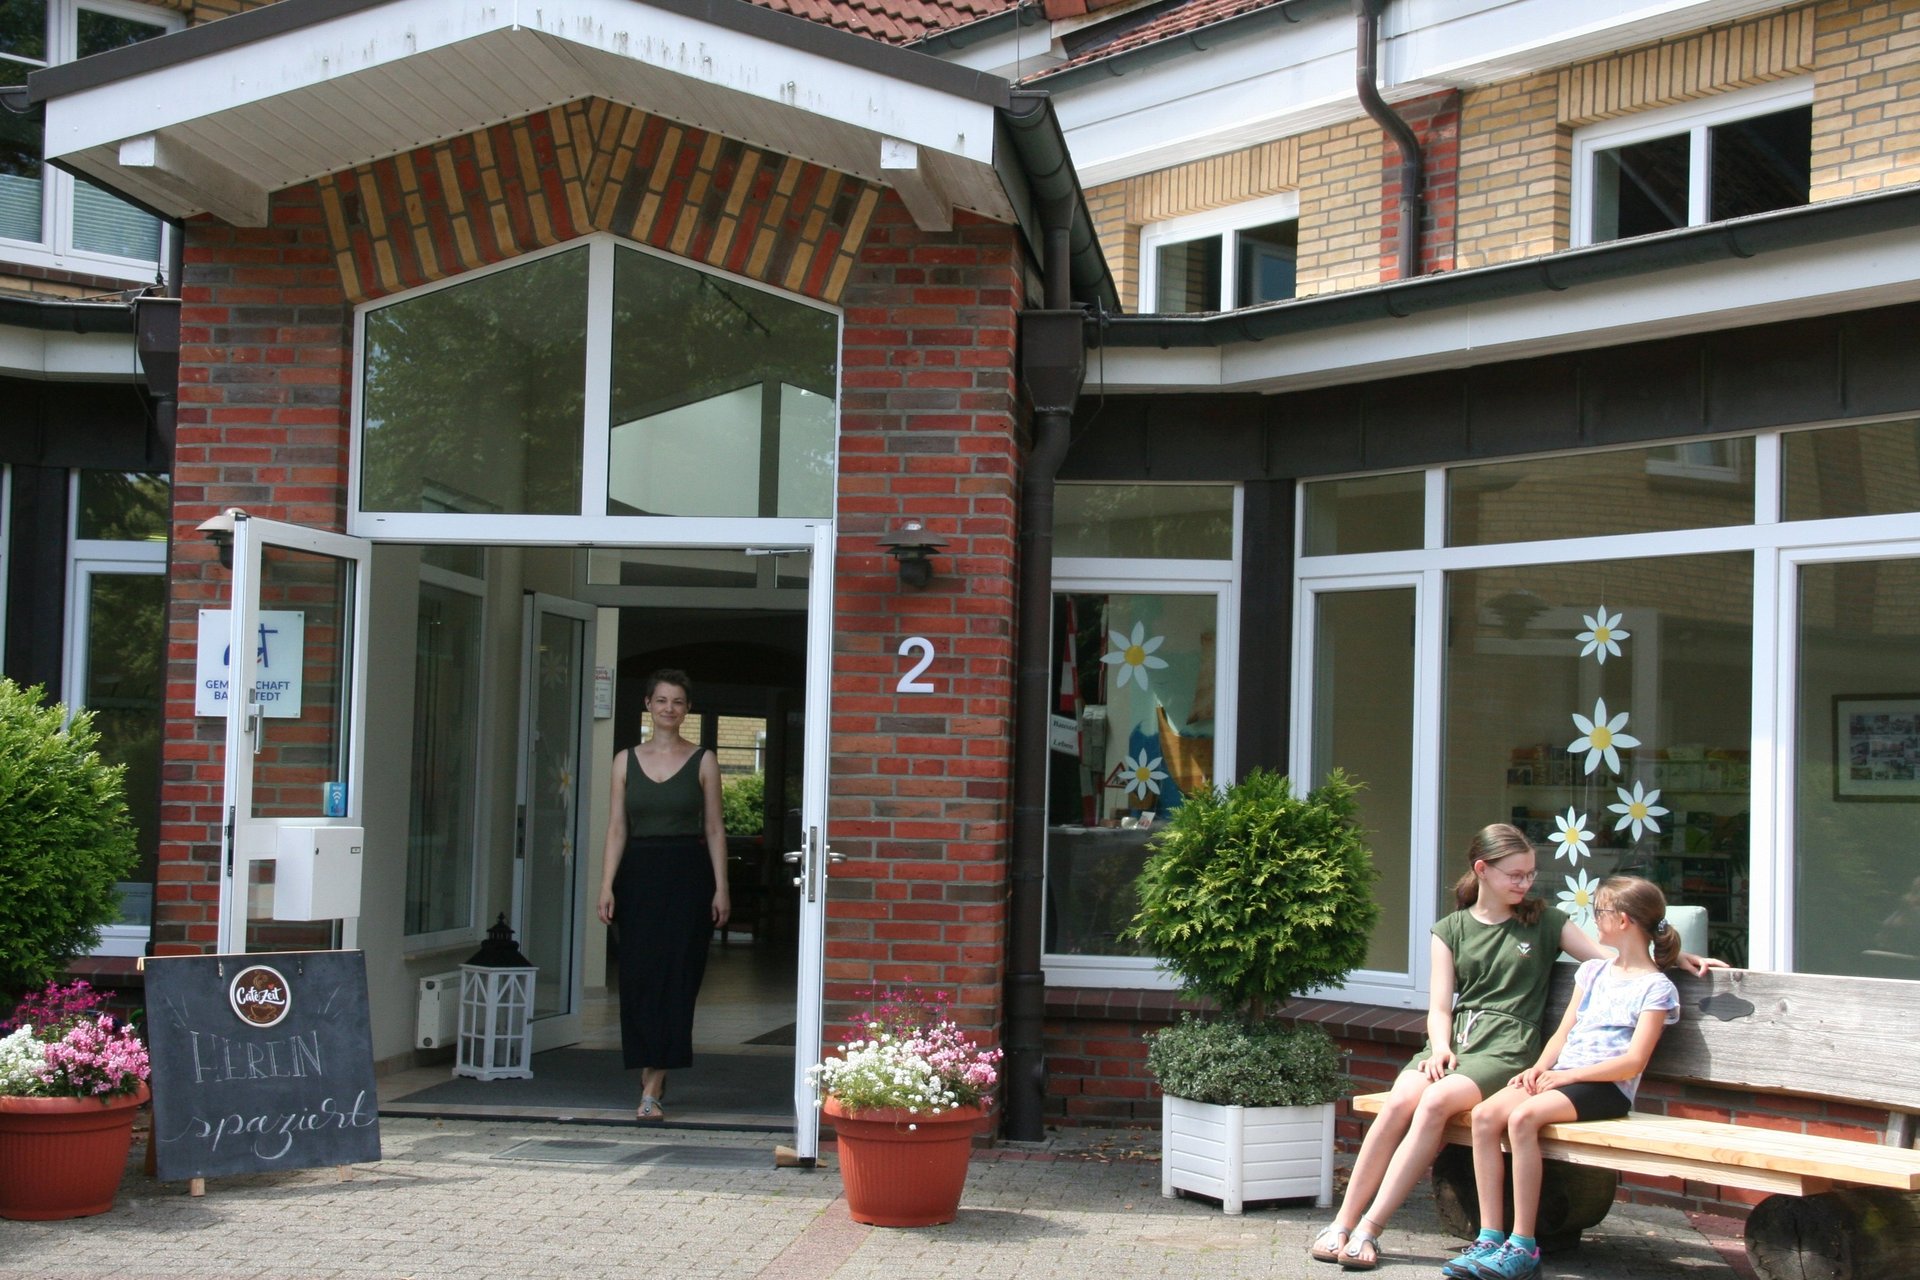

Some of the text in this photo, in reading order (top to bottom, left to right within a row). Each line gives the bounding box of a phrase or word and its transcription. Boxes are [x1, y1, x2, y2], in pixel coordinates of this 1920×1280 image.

[896, 636, 935, 693] 2
[190, 1030, 322, 1083] HEREIN
[160, 1089, 376, 1160] spaziert
